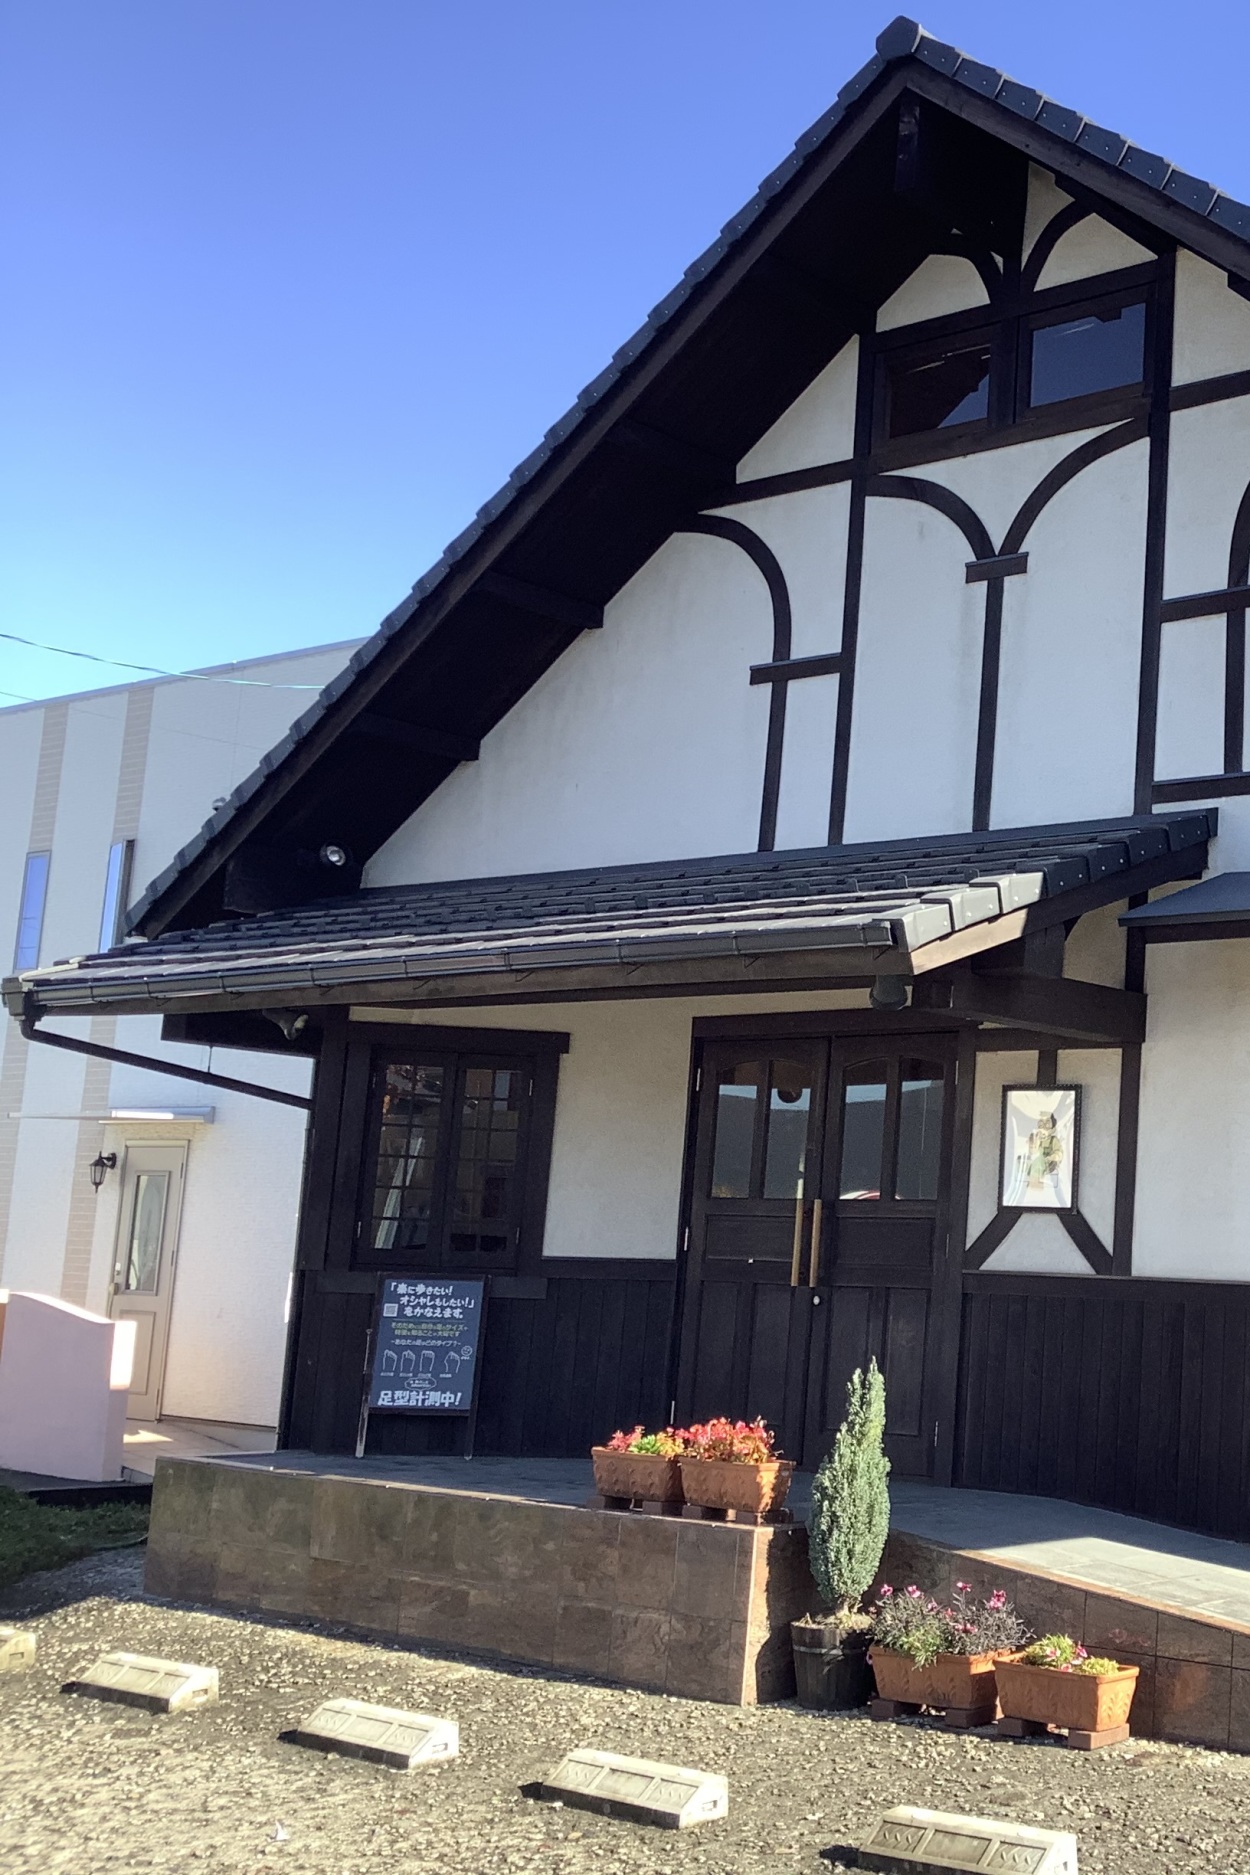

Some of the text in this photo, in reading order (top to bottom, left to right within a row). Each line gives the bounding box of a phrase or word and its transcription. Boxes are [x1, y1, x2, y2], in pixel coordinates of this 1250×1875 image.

[377, 1390, 462, 1407] 足型計測中!
